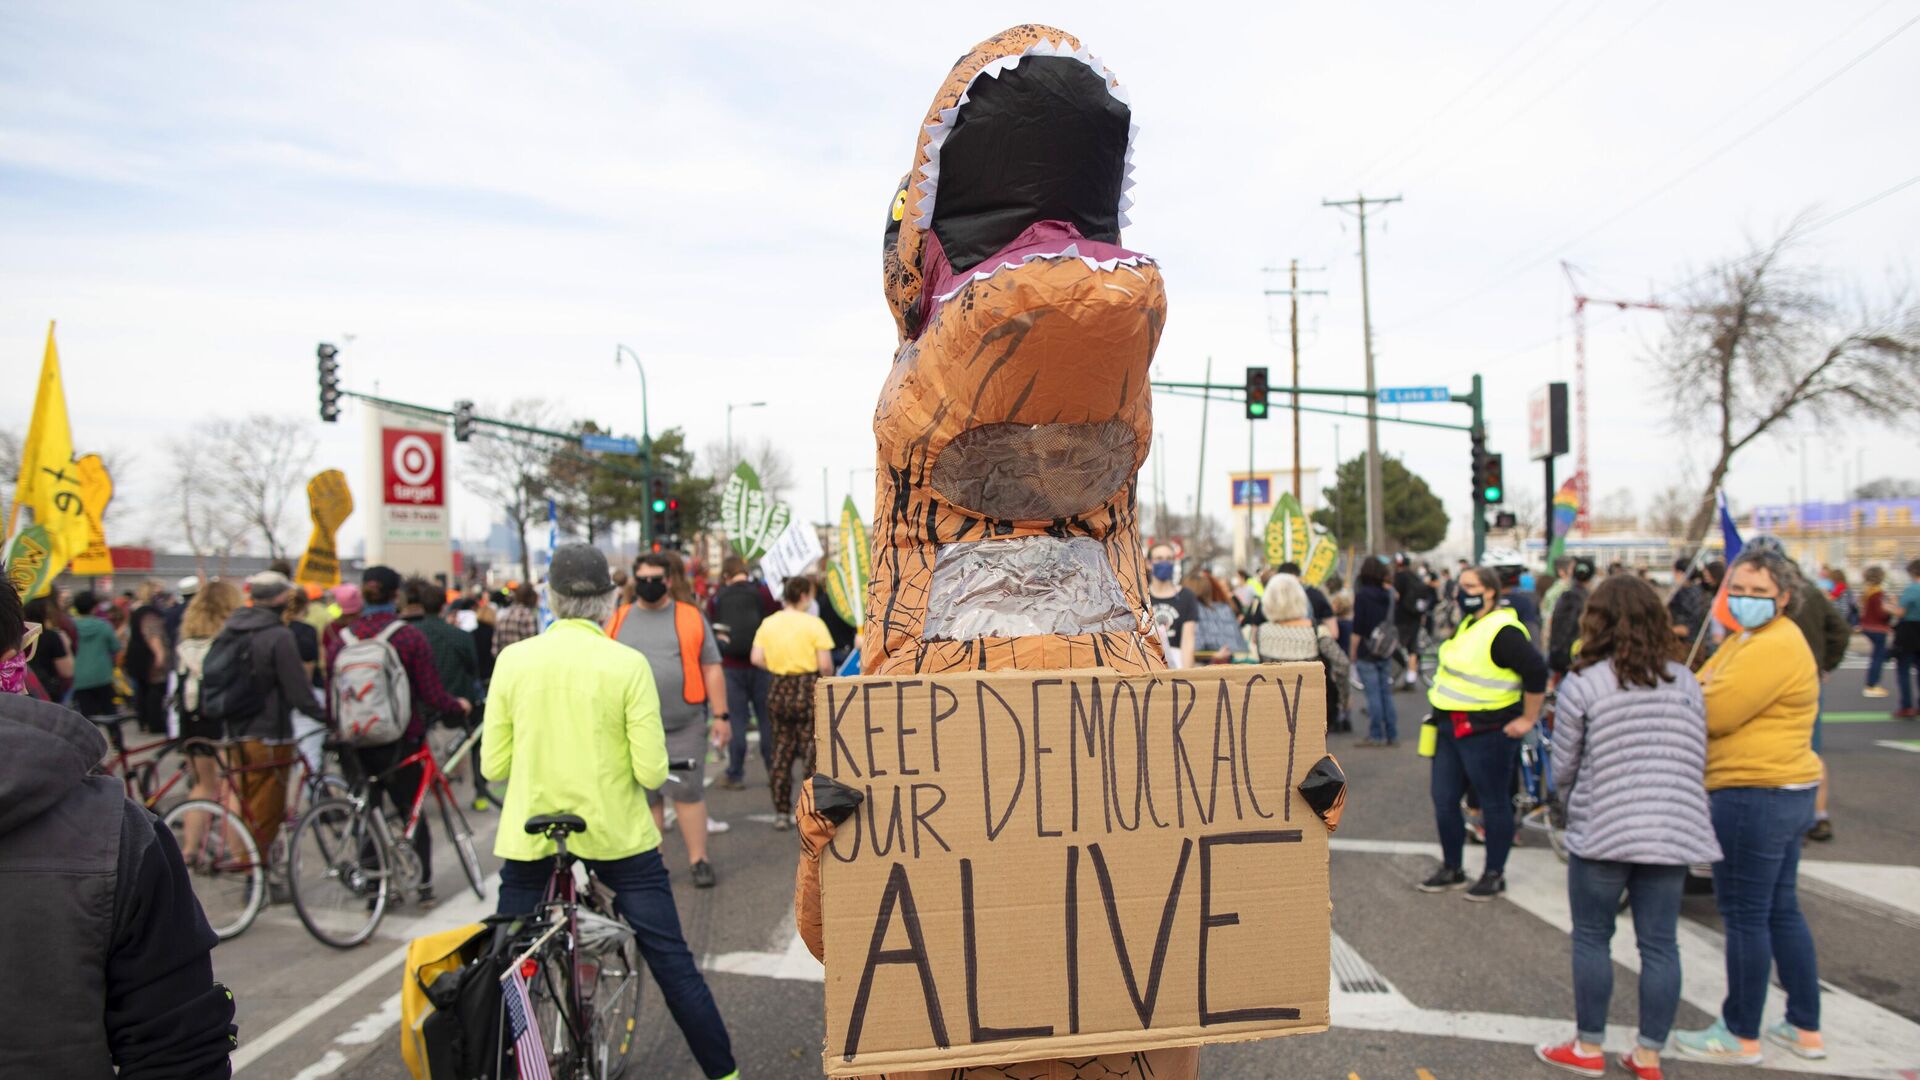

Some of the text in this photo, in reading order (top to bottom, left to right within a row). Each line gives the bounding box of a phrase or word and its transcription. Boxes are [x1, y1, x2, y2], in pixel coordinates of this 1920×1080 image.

[393, 484, 436, 504] target
[827, 674, 1304, 841] KEEP DEMOCRACY
[828, 784, 951, 863] OUR
[843, 829, 1302, 1062] ALIVE
